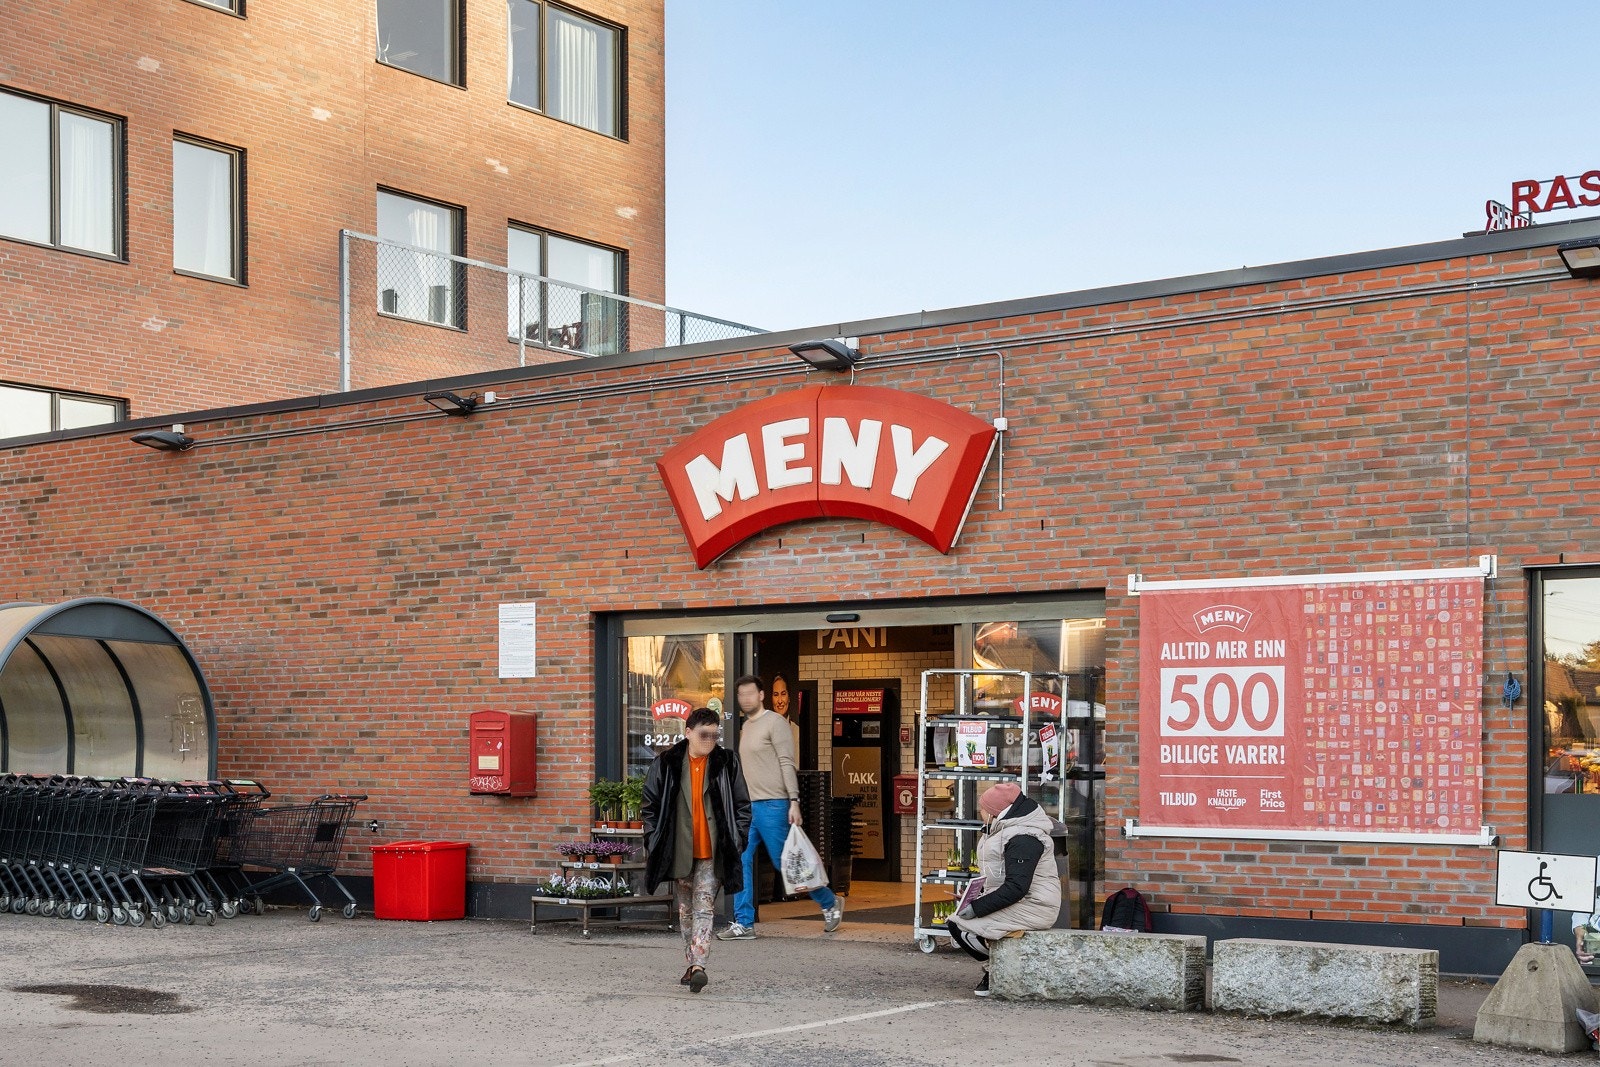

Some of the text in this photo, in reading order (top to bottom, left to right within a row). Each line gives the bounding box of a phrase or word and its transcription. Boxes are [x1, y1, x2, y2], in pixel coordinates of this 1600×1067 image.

[685, 417, 950, 521] MENY
[1200, 610, 1245, 626] MENY
[1160, 639, 1286, 660] ALLTID MER ENN
[1166, 672, 1279, 732] 500
[655, 702, 688, 715] MENY
[644, 734, 670, 746] 8-22
[1160, 744, 1286, 765] BILLIGE VARER!
[848, 772, 878, 784] TAKK.
[903, 794, 909, 803] T
[1159, 792, 1198, 806] TILBUD
[1216, 789, 1238, 798] FASTE
[1260, 789, 1282, 799] First
[1207, 798, 1247, 807] KNALLKJØP
[1260, 799, 1286, 808] Price
